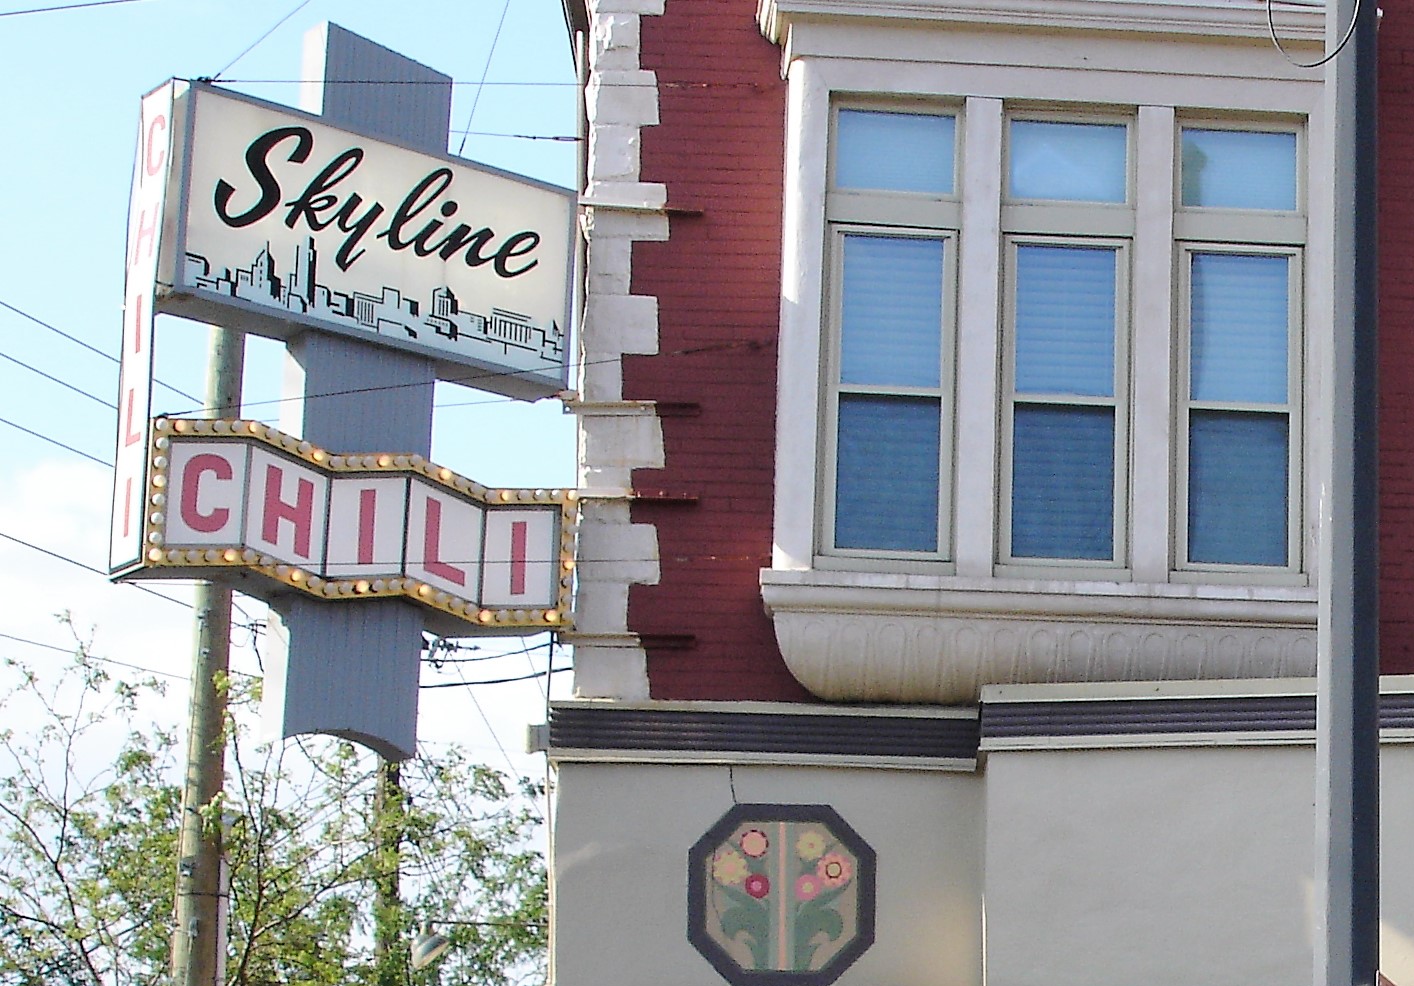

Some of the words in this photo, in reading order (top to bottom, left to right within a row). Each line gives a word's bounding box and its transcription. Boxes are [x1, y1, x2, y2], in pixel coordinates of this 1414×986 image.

[213, 126, 540, 278] Skyline
[120, 114, 169, 538] CHILI
[179, 453, 528, 596] CHILI
